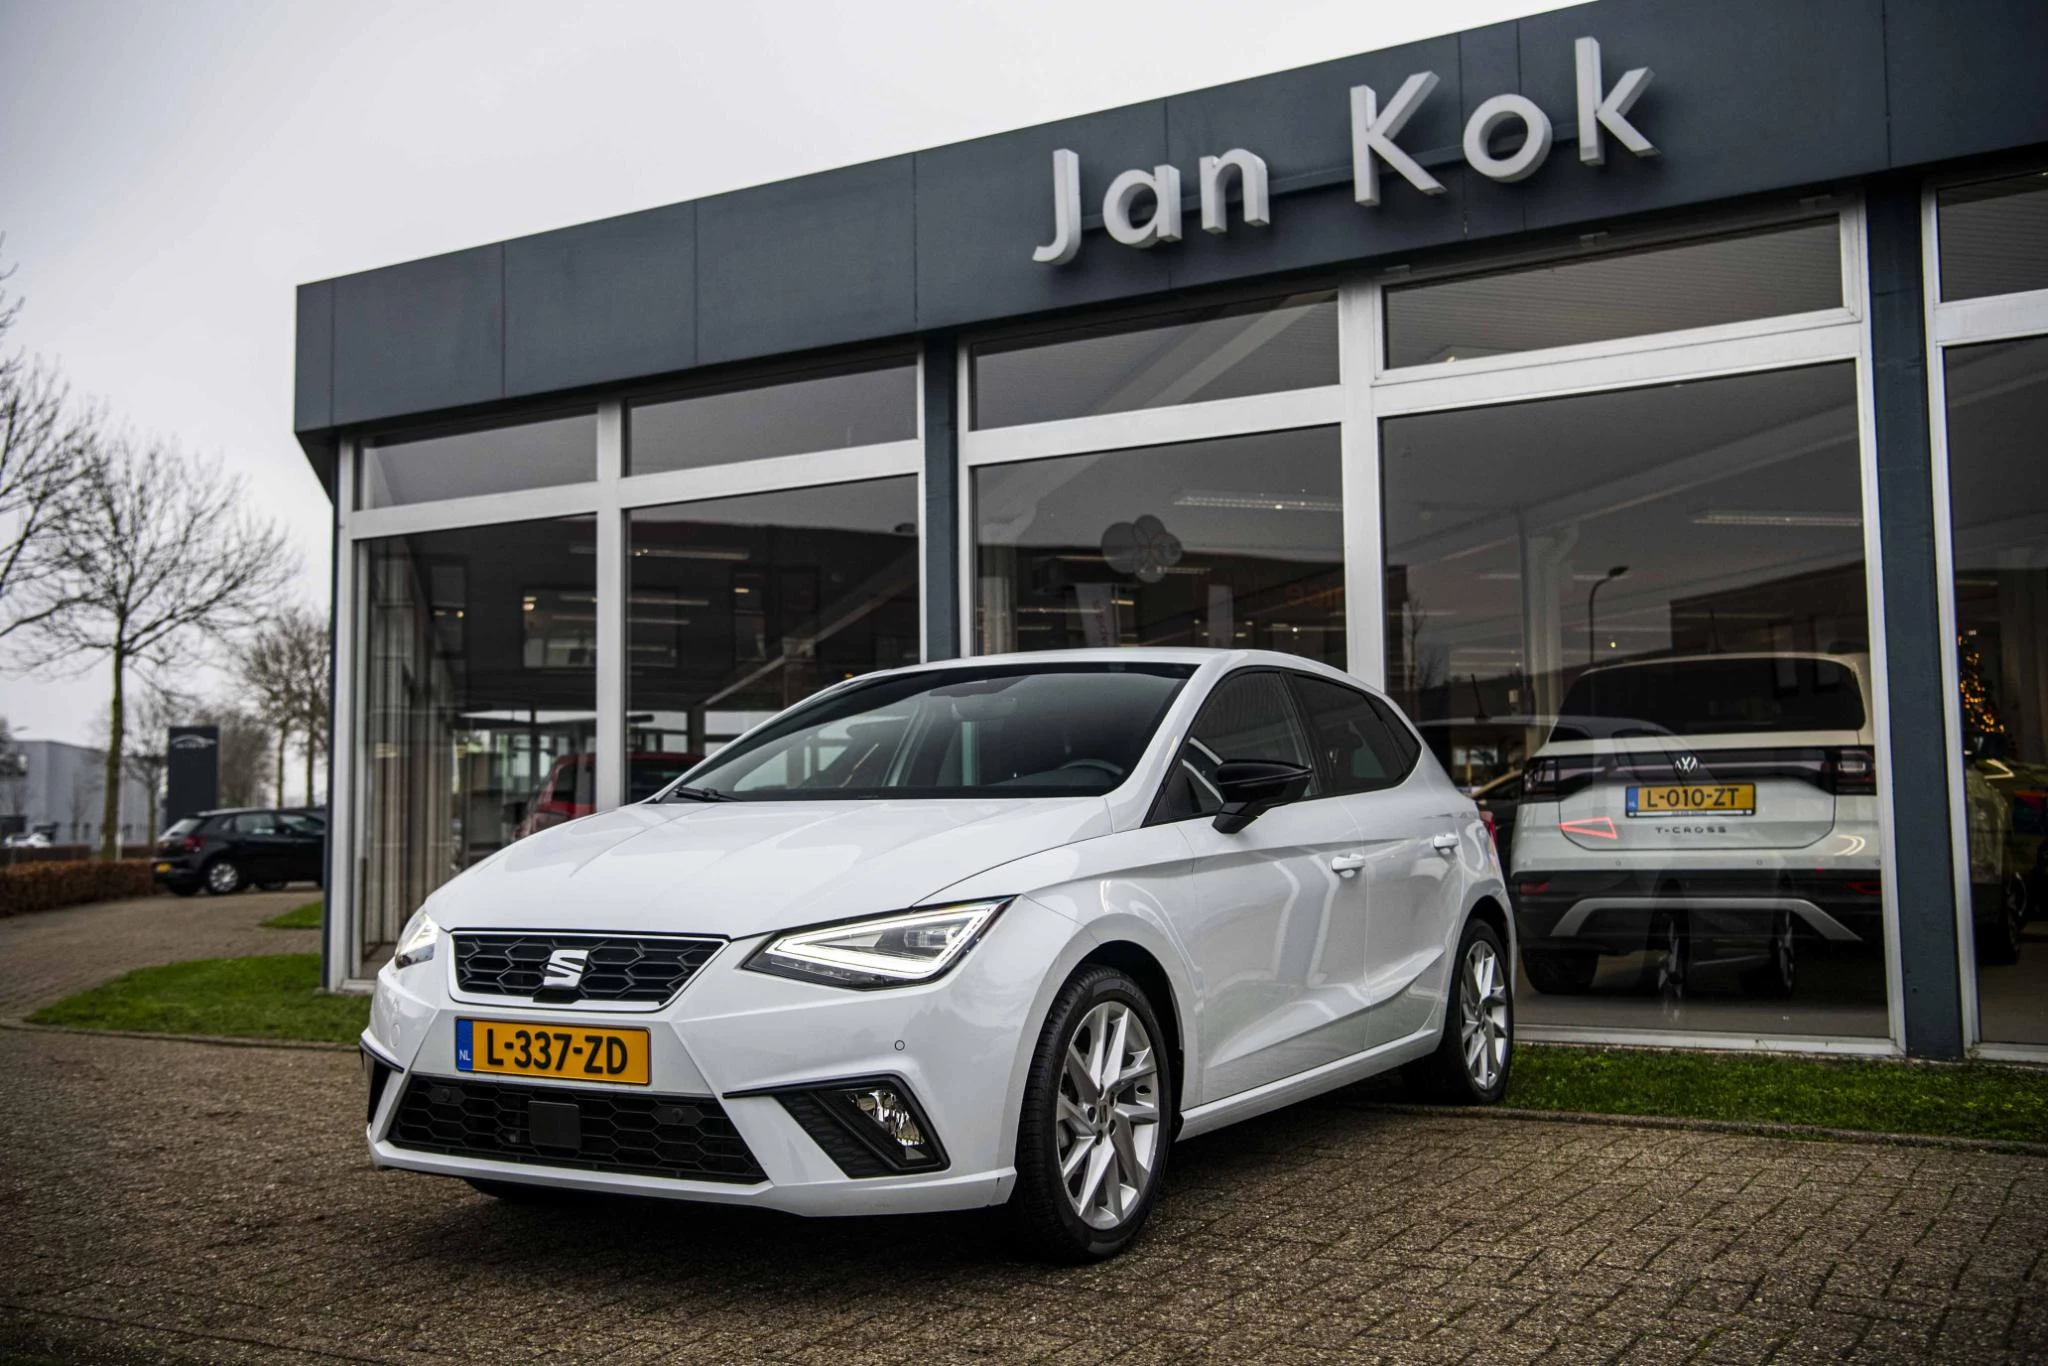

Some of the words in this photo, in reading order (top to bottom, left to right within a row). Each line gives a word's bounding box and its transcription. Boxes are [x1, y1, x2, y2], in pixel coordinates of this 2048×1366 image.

[1032, 148, 1270, 266] Jan
[1350, 36, 1661, 206] Kok
[1647, 788, 1739, 808] L-010-ZT
[1655, 826, 1727, 834] T-CROSS
[459, 1050, 471, 1061] NL
[487, 1028, 628, 1075] L-337-ZD
